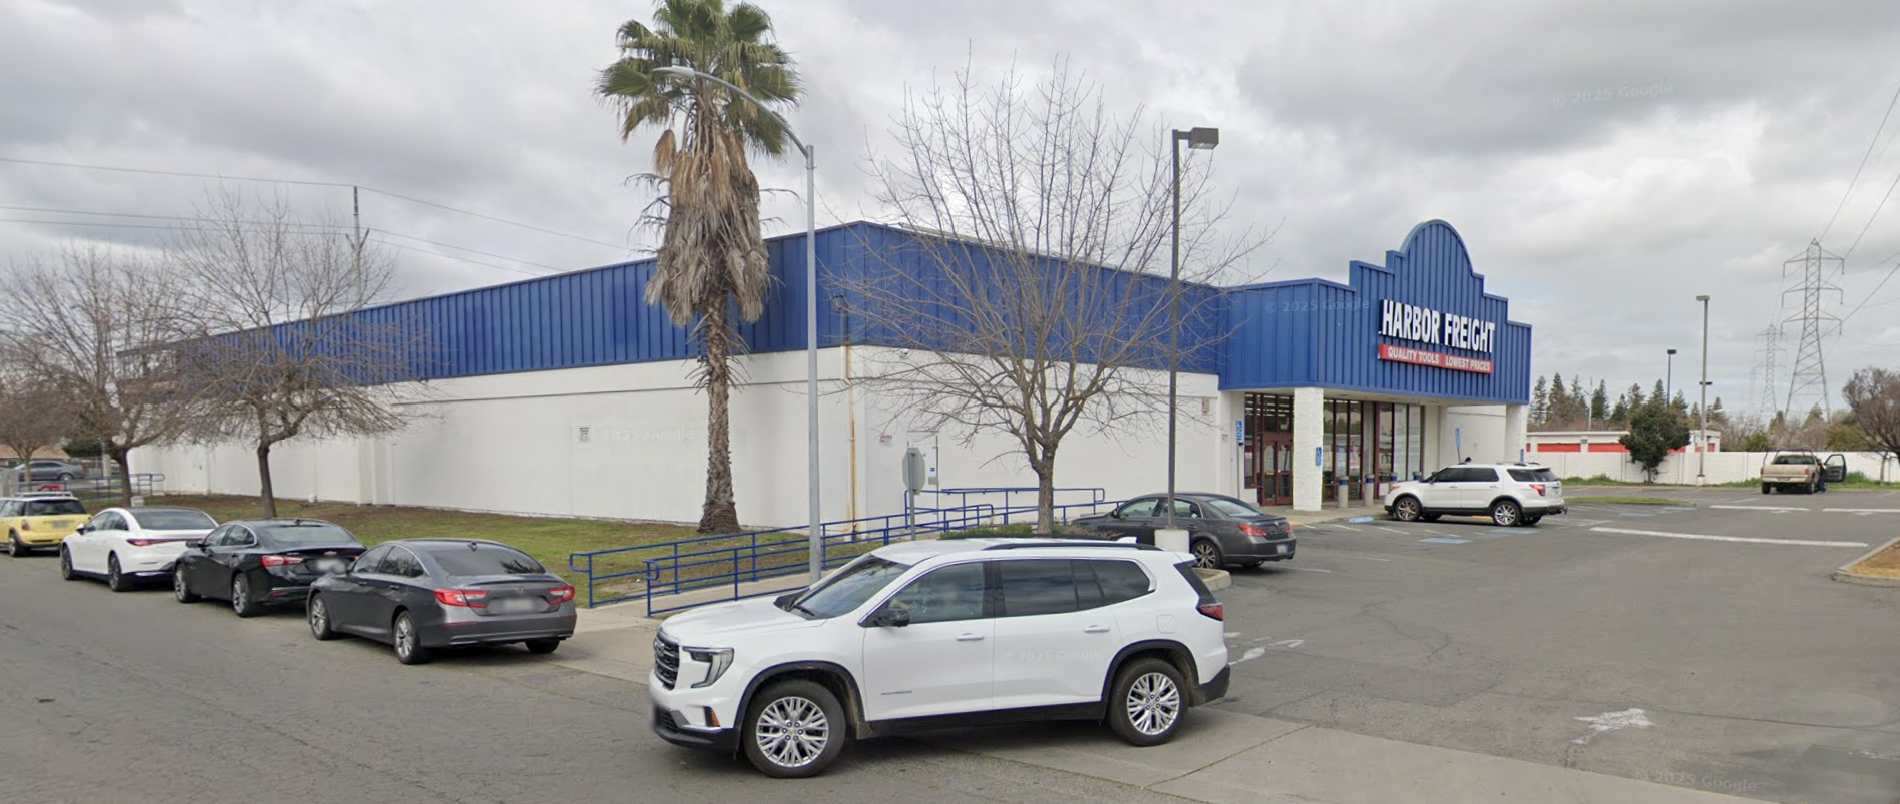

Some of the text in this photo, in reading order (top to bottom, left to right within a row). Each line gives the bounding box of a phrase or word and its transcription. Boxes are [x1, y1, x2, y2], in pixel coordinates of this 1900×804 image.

[1382, 299, 1496, 353] HARBOR FREIGHT
[1388, 346, 1491, 371] QUALITY TOOLS LOWEST PRICES
